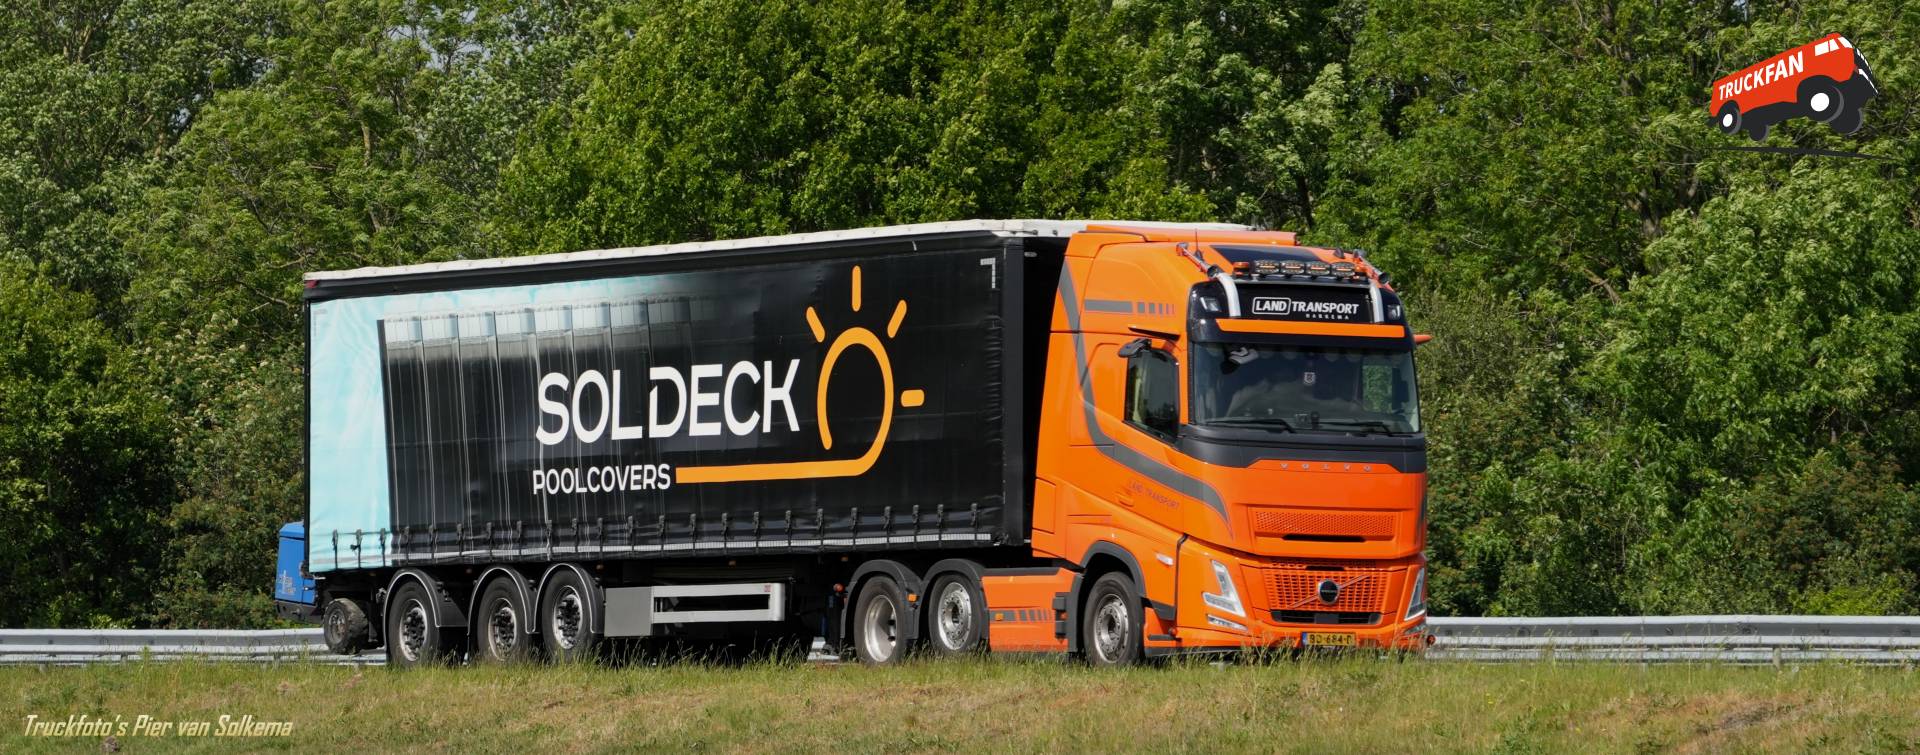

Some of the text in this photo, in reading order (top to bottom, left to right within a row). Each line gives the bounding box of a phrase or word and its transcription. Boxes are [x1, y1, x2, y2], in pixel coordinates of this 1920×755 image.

[1255, 300, 1360, 315] LAND TRANSPORT
[535, 358, 801, 446] SOLDECK
[532, 463, 672, 495] POOLCOVERS
[1280, 462, 1372, 473] VOLVO
